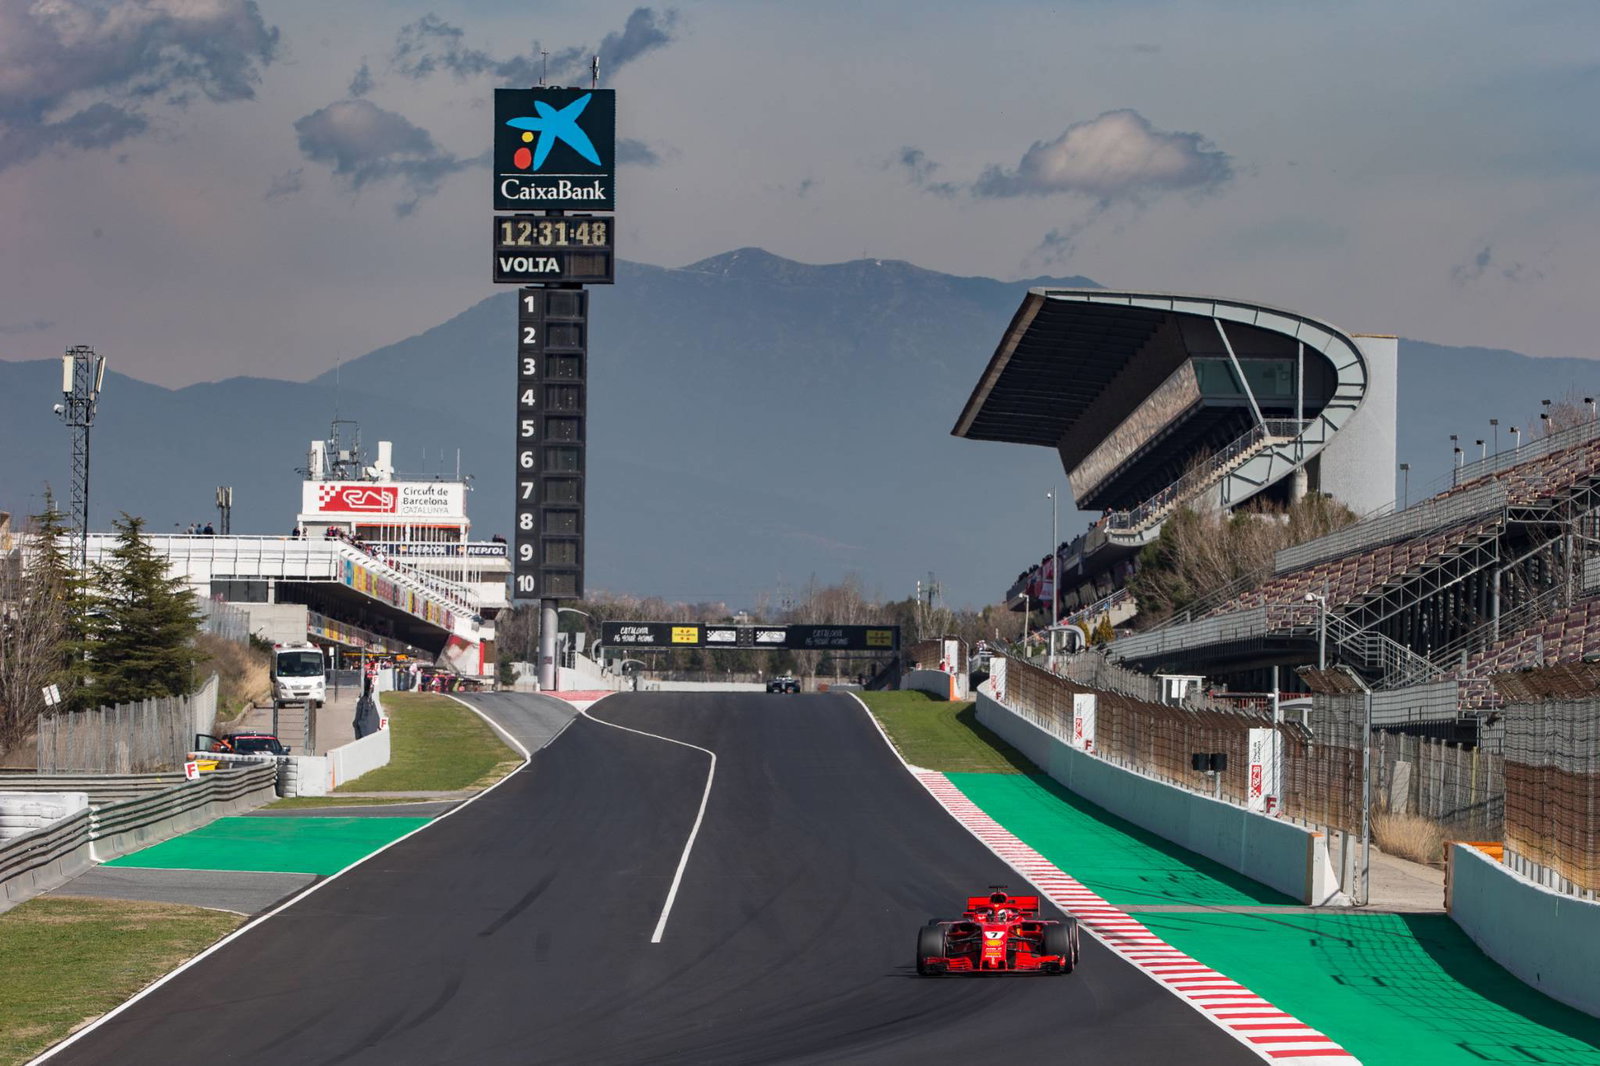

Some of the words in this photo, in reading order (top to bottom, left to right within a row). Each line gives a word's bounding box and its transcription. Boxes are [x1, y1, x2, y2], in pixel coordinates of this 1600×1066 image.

[501, 178, 606, 200] CaixaBank
[501, 221, 606, 246] 12:31:48
[499, 257, 560, 273] VOLTA
[524, 296, 534, 313] 1
[523, 327, 536, 344] 2
[523, 358, 536, 375] 3
[521, 389, 536, 406] 4
[521, 420, 535, 437] 5
[520, 451, 534, 468] 6
[437, 488, 449, 496] de
[521, 482, 534, 499] 7
[403, 497, 448, 505] Barcelona
[403, 506, 449, 514] CATALUNYA
[520, 513, 534, 530] 8
[409, 545, 447, 554] REPSOL
[467, 545, 504, 555] REPSOL
[520, 544, 533, 561] 9
[517, 575, 535, 592] 10
[381, 719, 387, 728] F
[1085, 739, 1092, 750] F
[187, 764, 196, 777] F
[1266, 797, 1276, 813] F
